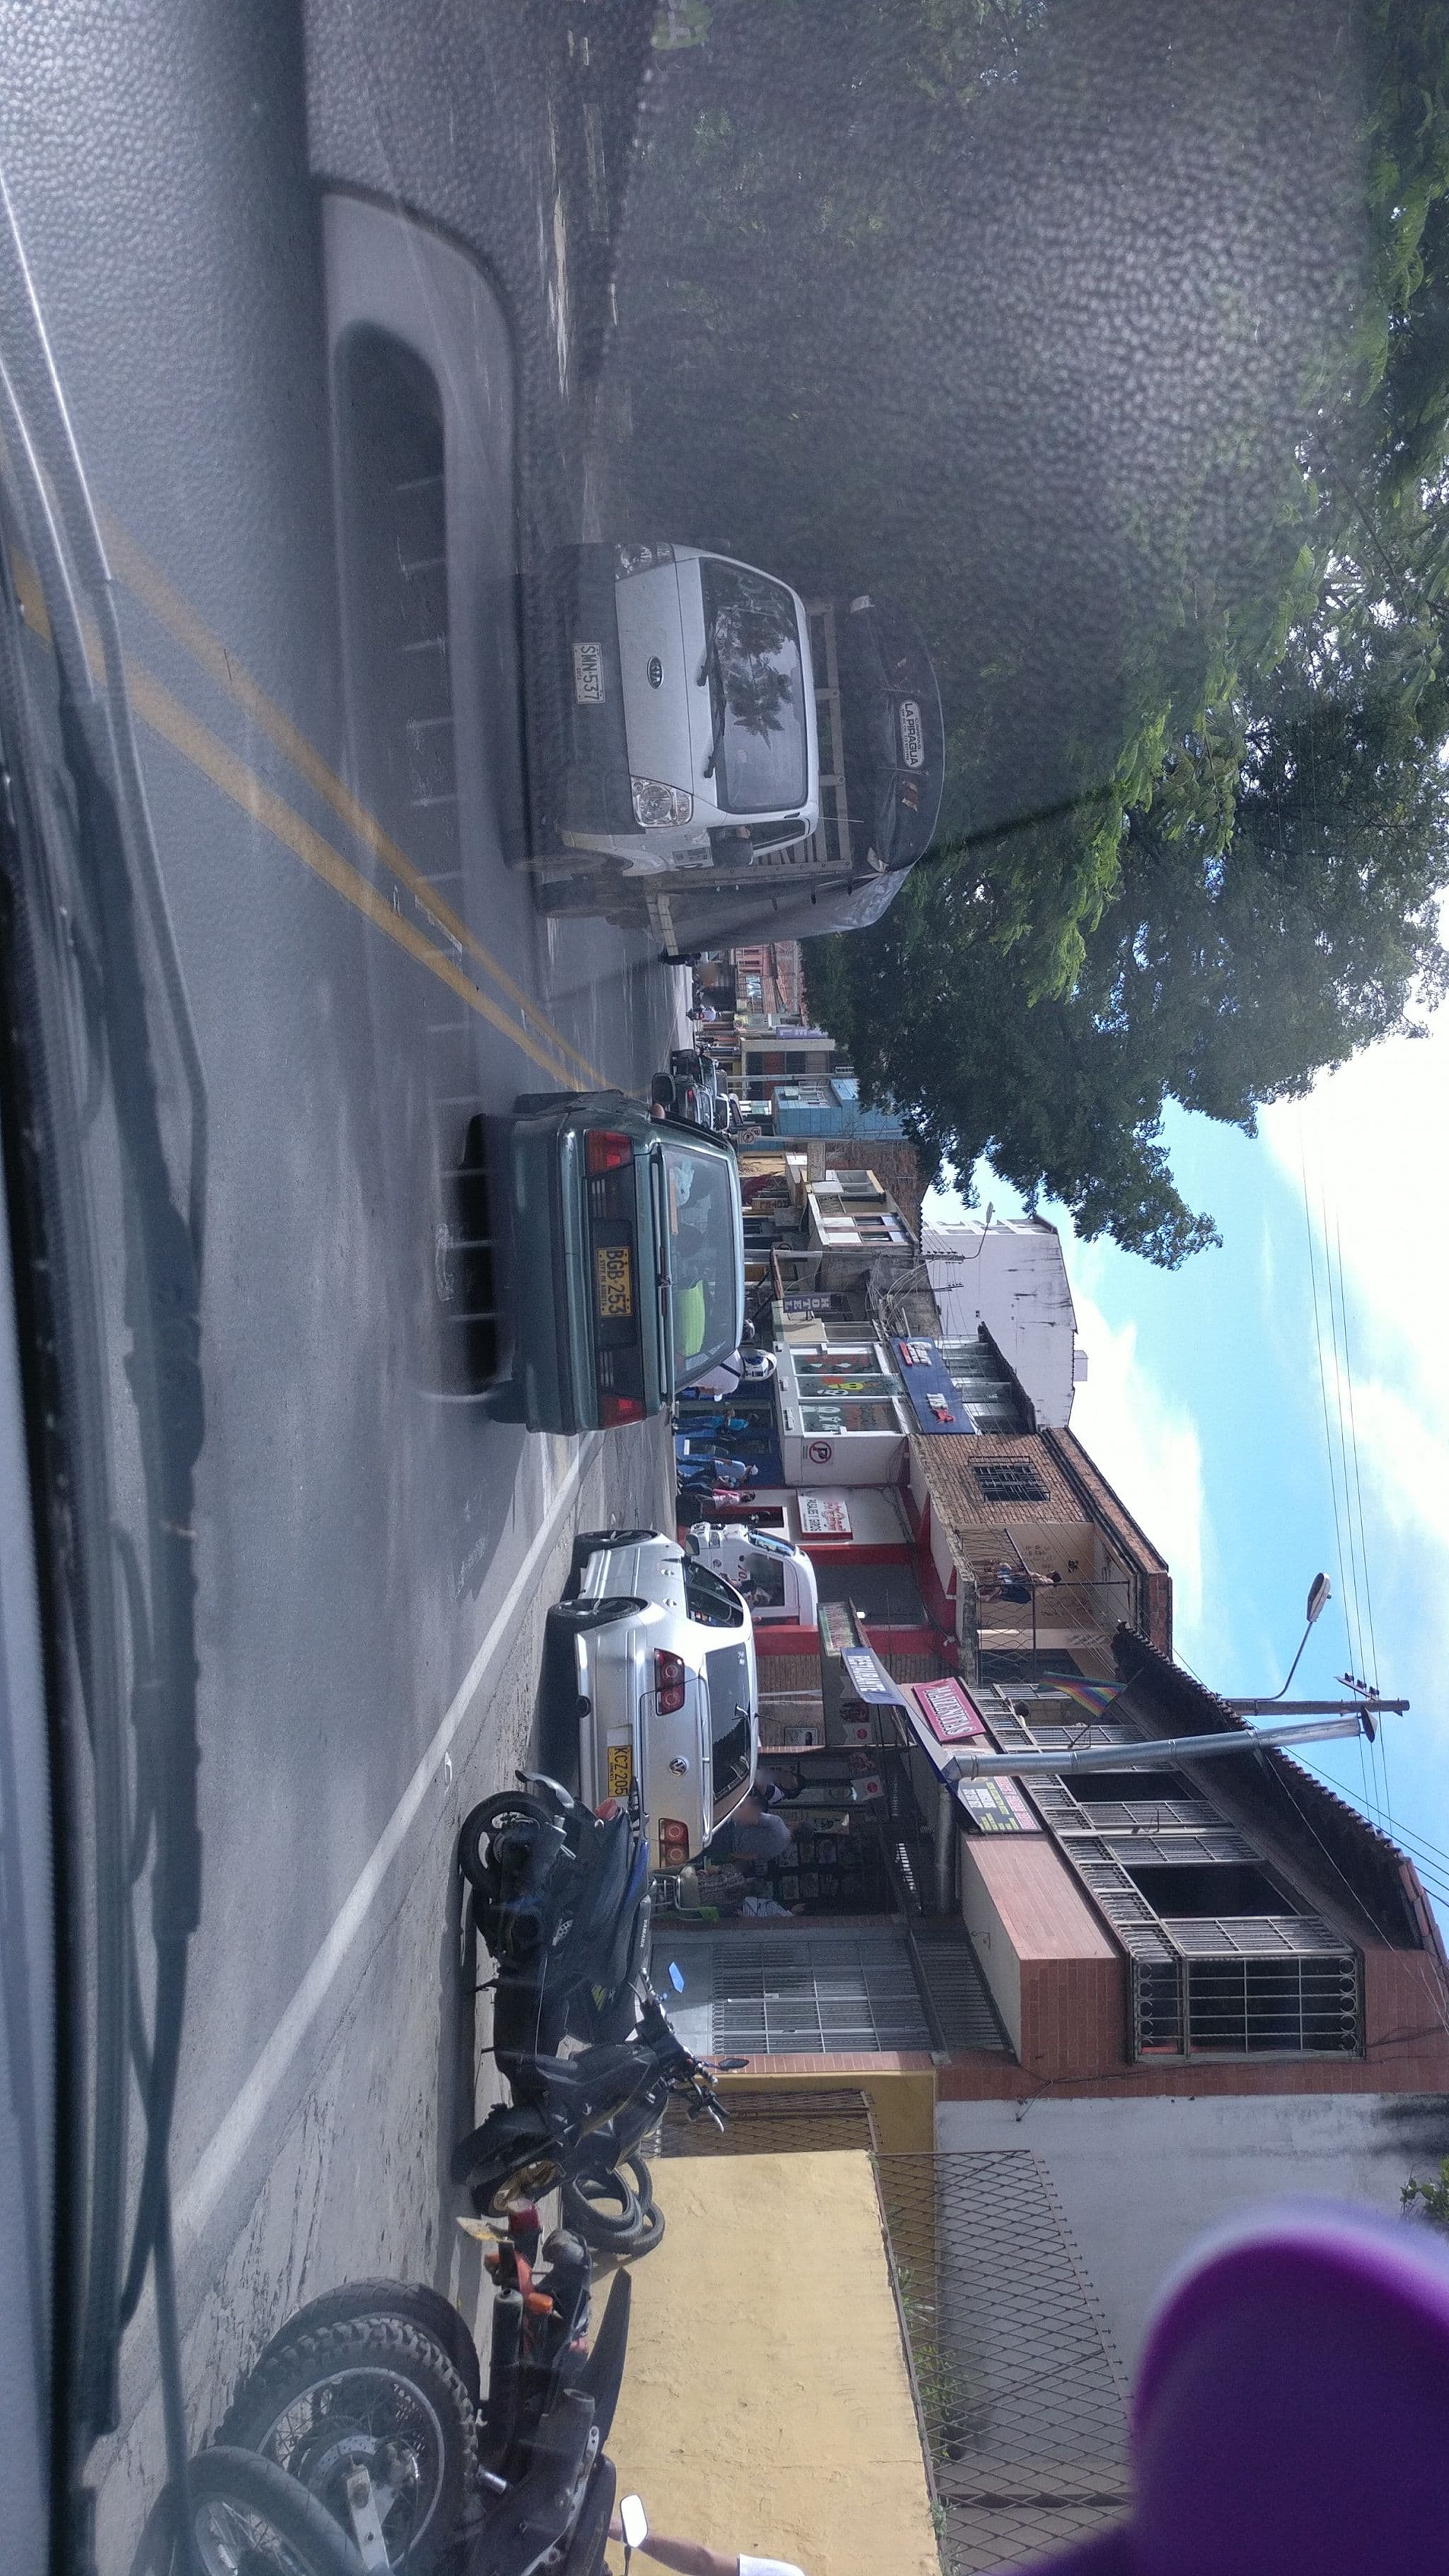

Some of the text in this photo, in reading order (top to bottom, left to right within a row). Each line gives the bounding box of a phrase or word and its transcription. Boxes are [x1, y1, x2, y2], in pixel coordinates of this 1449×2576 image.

[905, 703, 918, 765] LA PIRAGUA
[785, 1297, 829, 1311] HOTEL
[807, 1499, 819, 1514] PASAJES
[809, 1519, 821, 1531] GIROS
[847, 1655, 886, 1691] RESTAURANTE
[924, 1686, 976, 1735] MAIZENITAS
